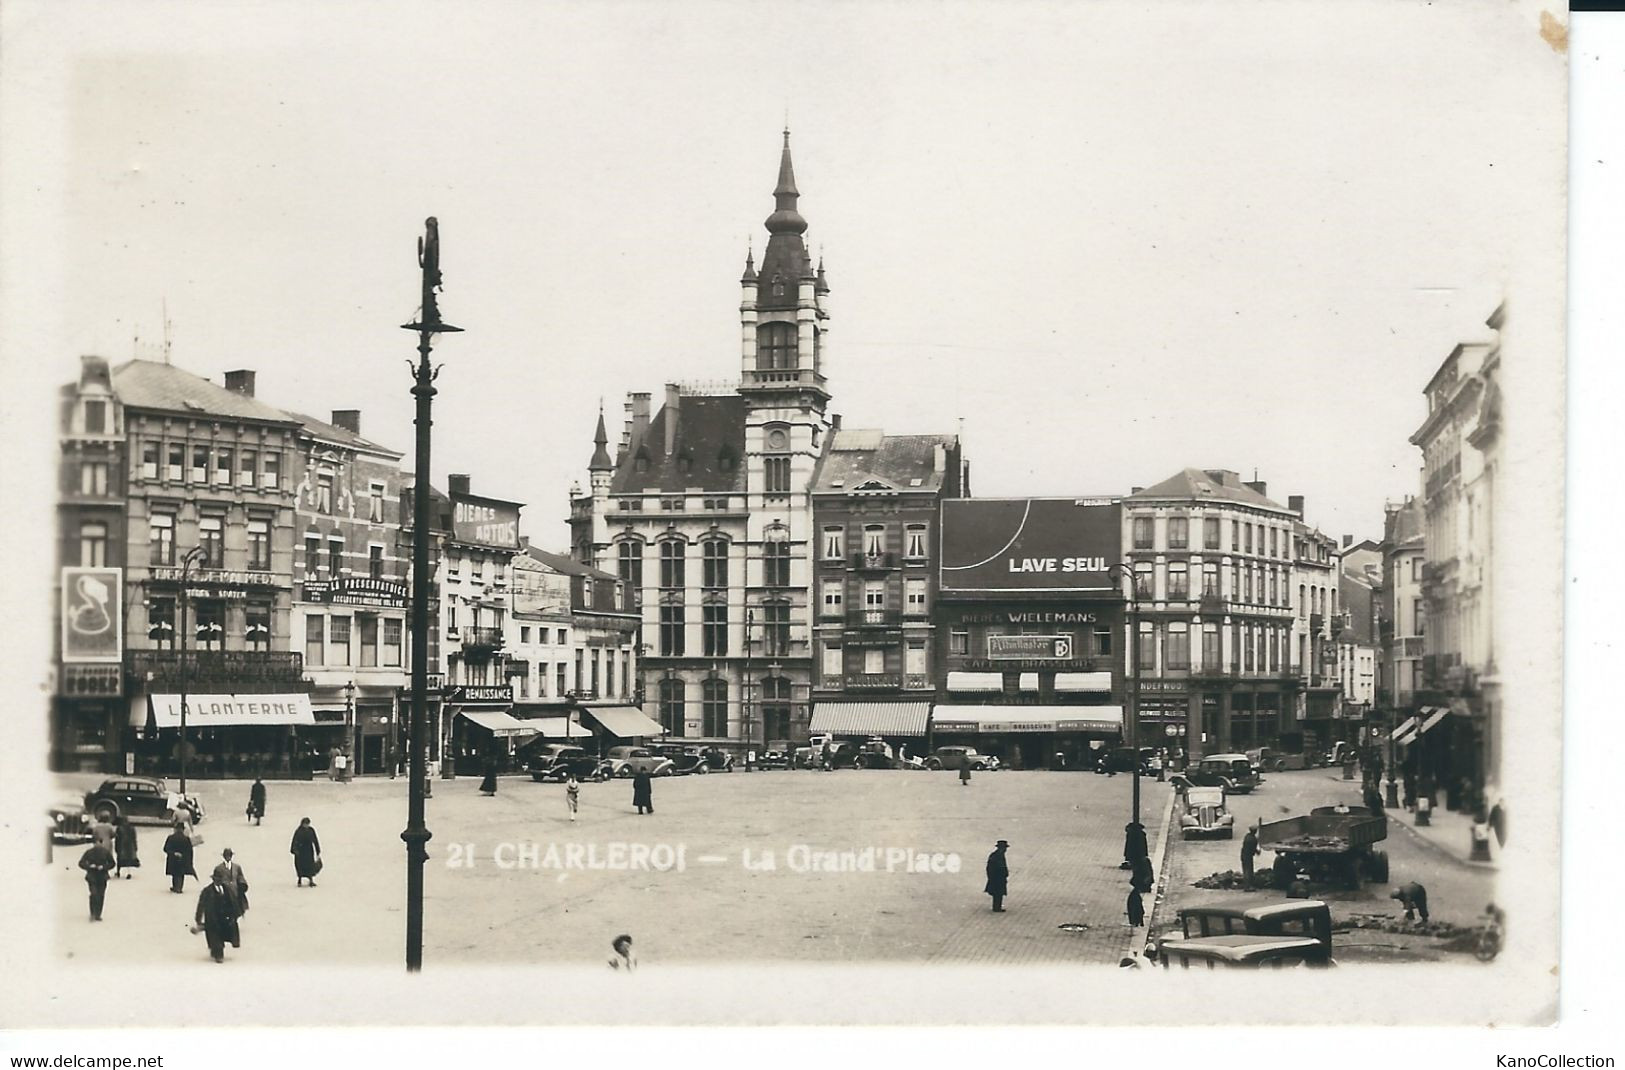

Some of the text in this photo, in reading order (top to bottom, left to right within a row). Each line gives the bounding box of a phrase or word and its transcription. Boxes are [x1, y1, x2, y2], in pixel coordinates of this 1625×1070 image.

[456, 502, 496, 523] BIERES
[476, 521, 516, 545] ARTOIS
[1009, 557, 1110, 572] LAVE SEUL
[1008, 613, 1097, 623] WIELEMANS
[465, 688, 512, 700] RENAISSANCE
[168, 703, 298, 716] LA LANTERNE
